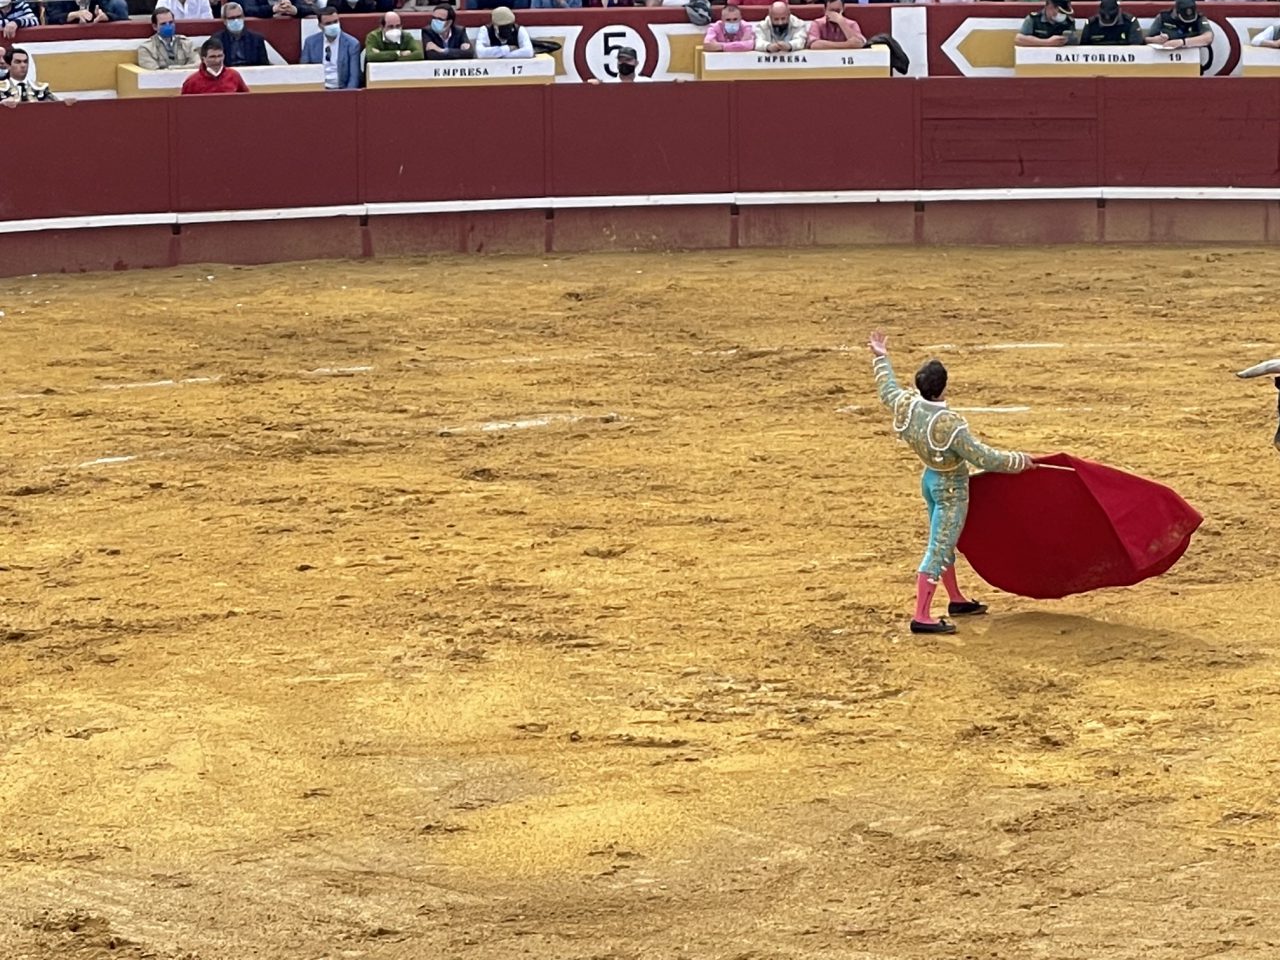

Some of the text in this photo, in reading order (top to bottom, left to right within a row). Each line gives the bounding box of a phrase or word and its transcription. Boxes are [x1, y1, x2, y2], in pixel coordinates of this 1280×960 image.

[603, 31, 627, 78] 5
[757, 55, 808, 64] EMPRESA
[433, 65, 524, 77] EMPRESA 17
